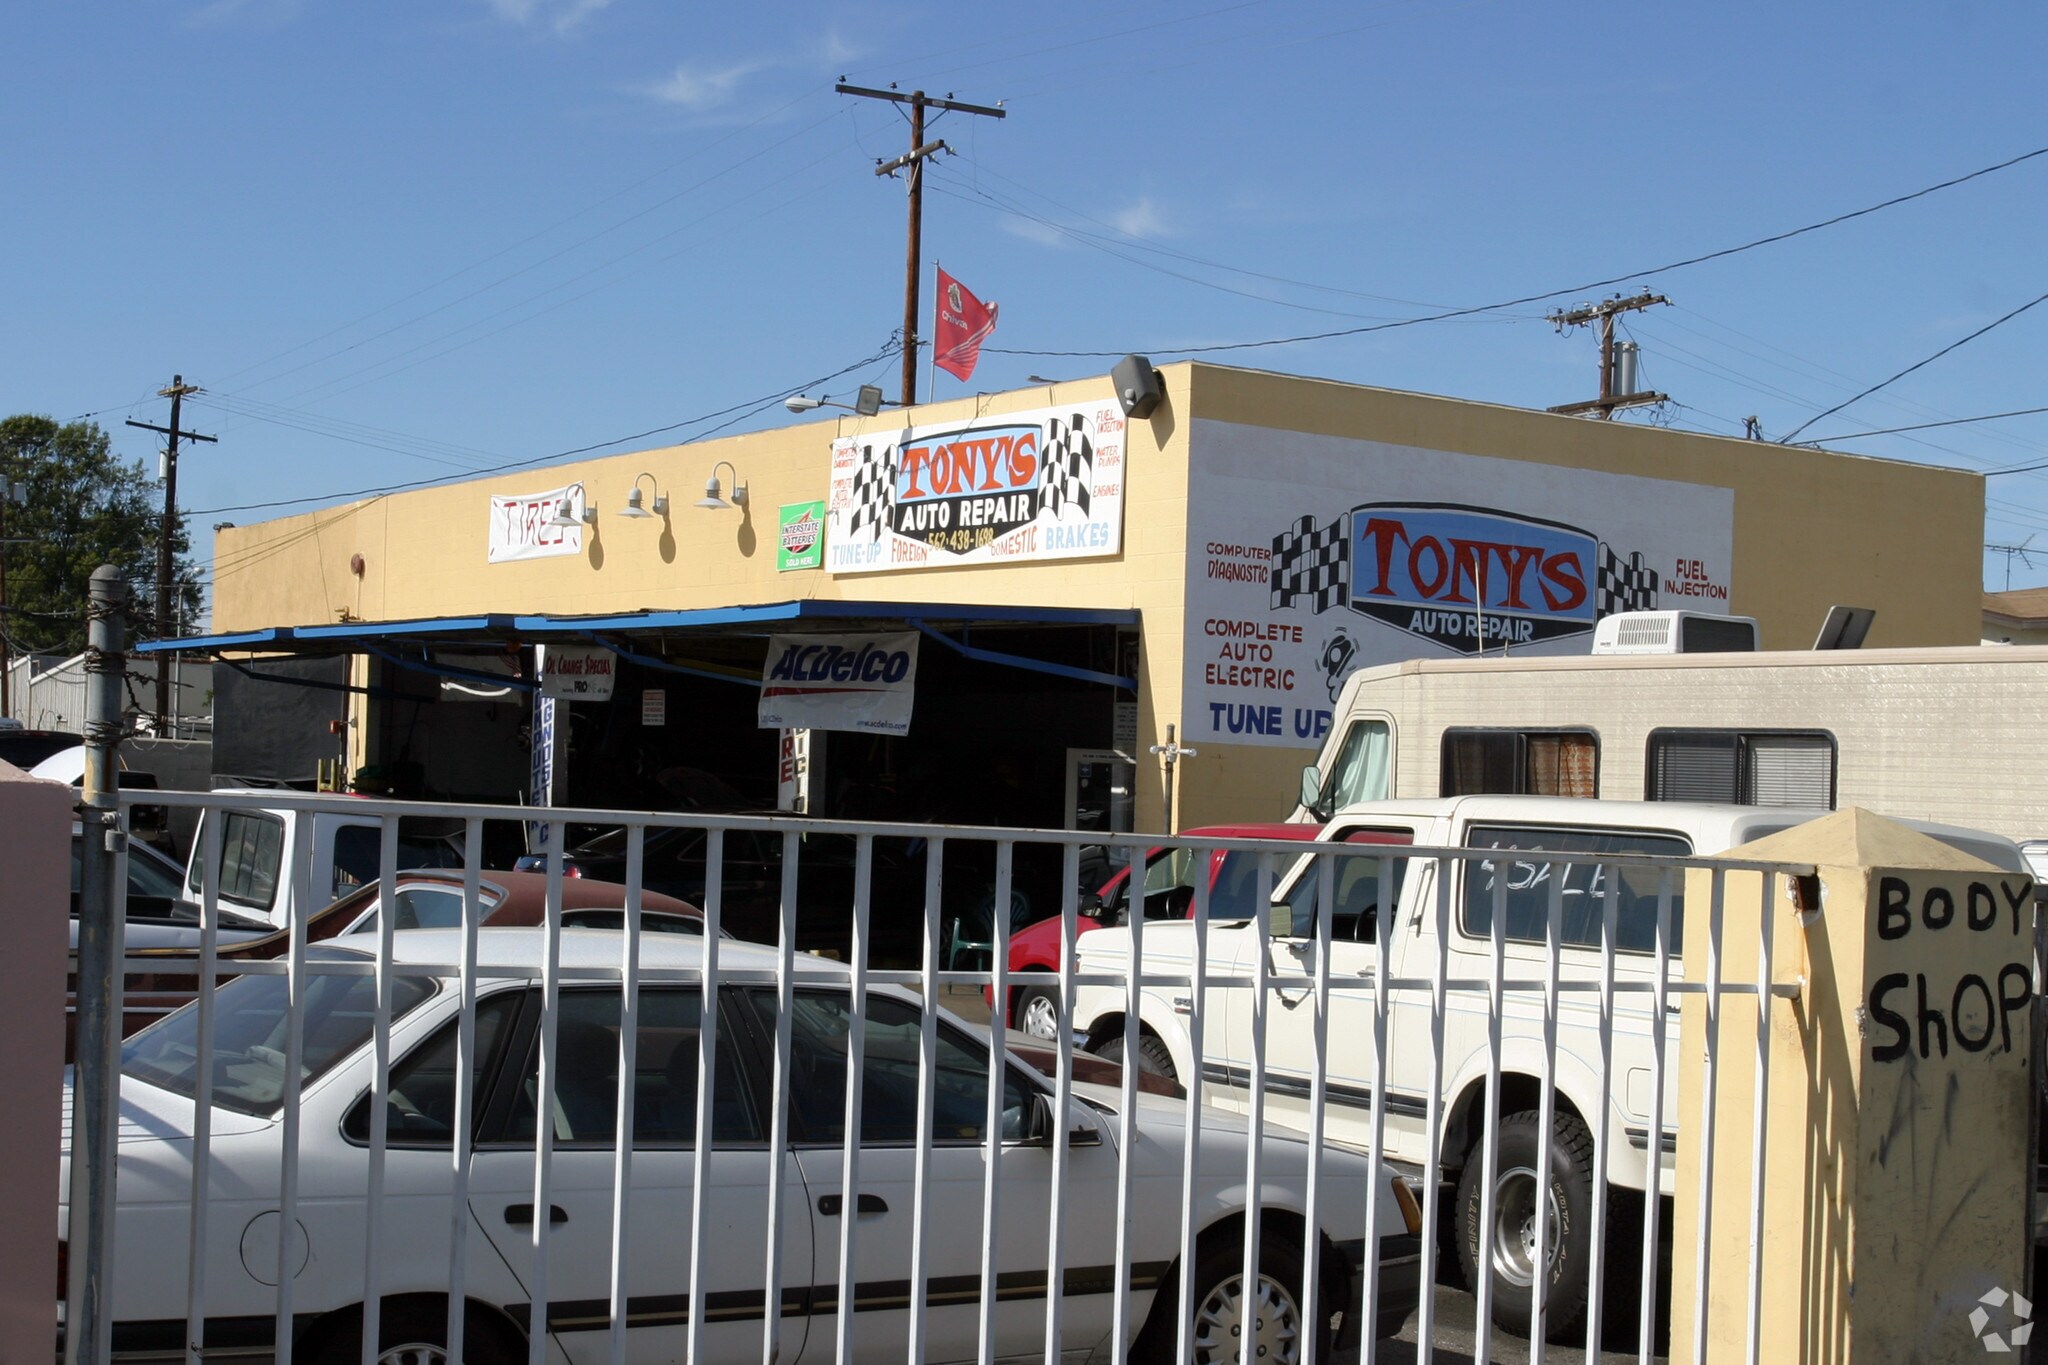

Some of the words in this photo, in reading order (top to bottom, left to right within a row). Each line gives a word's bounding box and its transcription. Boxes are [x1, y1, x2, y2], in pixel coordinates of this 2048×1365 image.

[1096, 409, 1114, 422] FUEL
[901, 432, 1037, 499] TONY'S
[900, 501, 950, 532] AUTO
[959, 494, 1030, 527] REPAIR
[783, 521, 820, 534] INTERSTATE
[783, 533, 816, 546] BATTERIES
[990, 525, 1038, 557] DOMESTIC
[1046, 522, 1109, 551] BRAKES
[832, 542, 881, 565] TUNE-UP
[891, 537, 928, 563] FOREIGN
[1206, 542, 1272, 561] COMPUTER
[1361, 517, 1588, 612] TONY'S
[1676, 558, 1708, 581] FUEL
[1204, 619, 1303, 643] COMPLETE
[1409, 610, 1463, 635] AUTO
[1465, 615, 1534, 642] REPAIR
[770, 642, 910, 684] ACDelco
[1219, 642, 1274, 663] AUTO
[1205, 664, 1296, 691] ELECTRIC
[1209, 702, 1283, 736] TUNE
[1878, 876, 2033, 940] BODY
